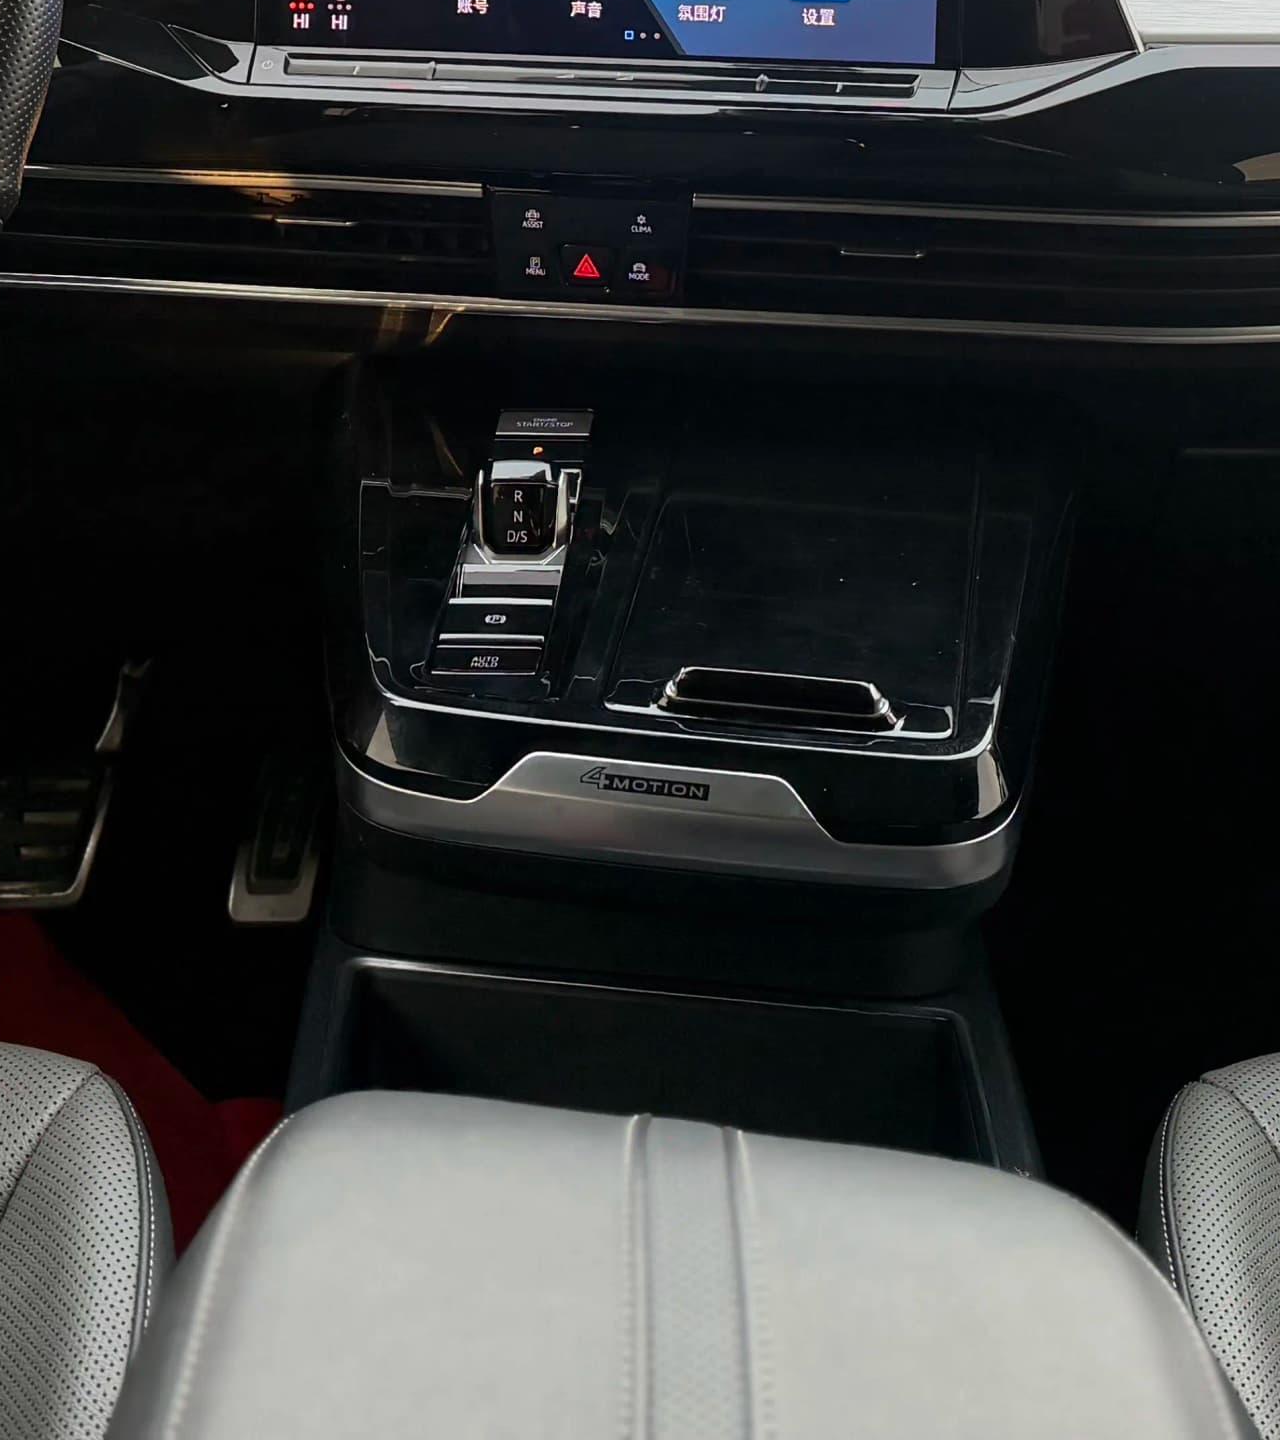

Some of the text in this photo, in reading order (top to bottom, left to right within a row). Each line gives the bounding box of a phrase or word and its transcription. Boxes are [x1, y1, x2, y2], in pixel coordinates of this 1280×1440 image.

[570, 0, 602, 19] 声音
[677, 4, 726, 22] 氛围灯
[293, 13, 310, 30] HI
[331, 14, 348, 31] HI
[802, 8, 835, 26] 设置
[522, 220, 544, 229] ASSIST
[631, 225, 652, 233] CLIMA
[525, 267, 546, 276] MENU
[628, 272, 650, 281] MODE
[514, 490, 523, 502] R
[513, 510, 523, 523] N
[506, 530, 528, 543] D/S
[580, 766, 710, 801] 4MOTION
